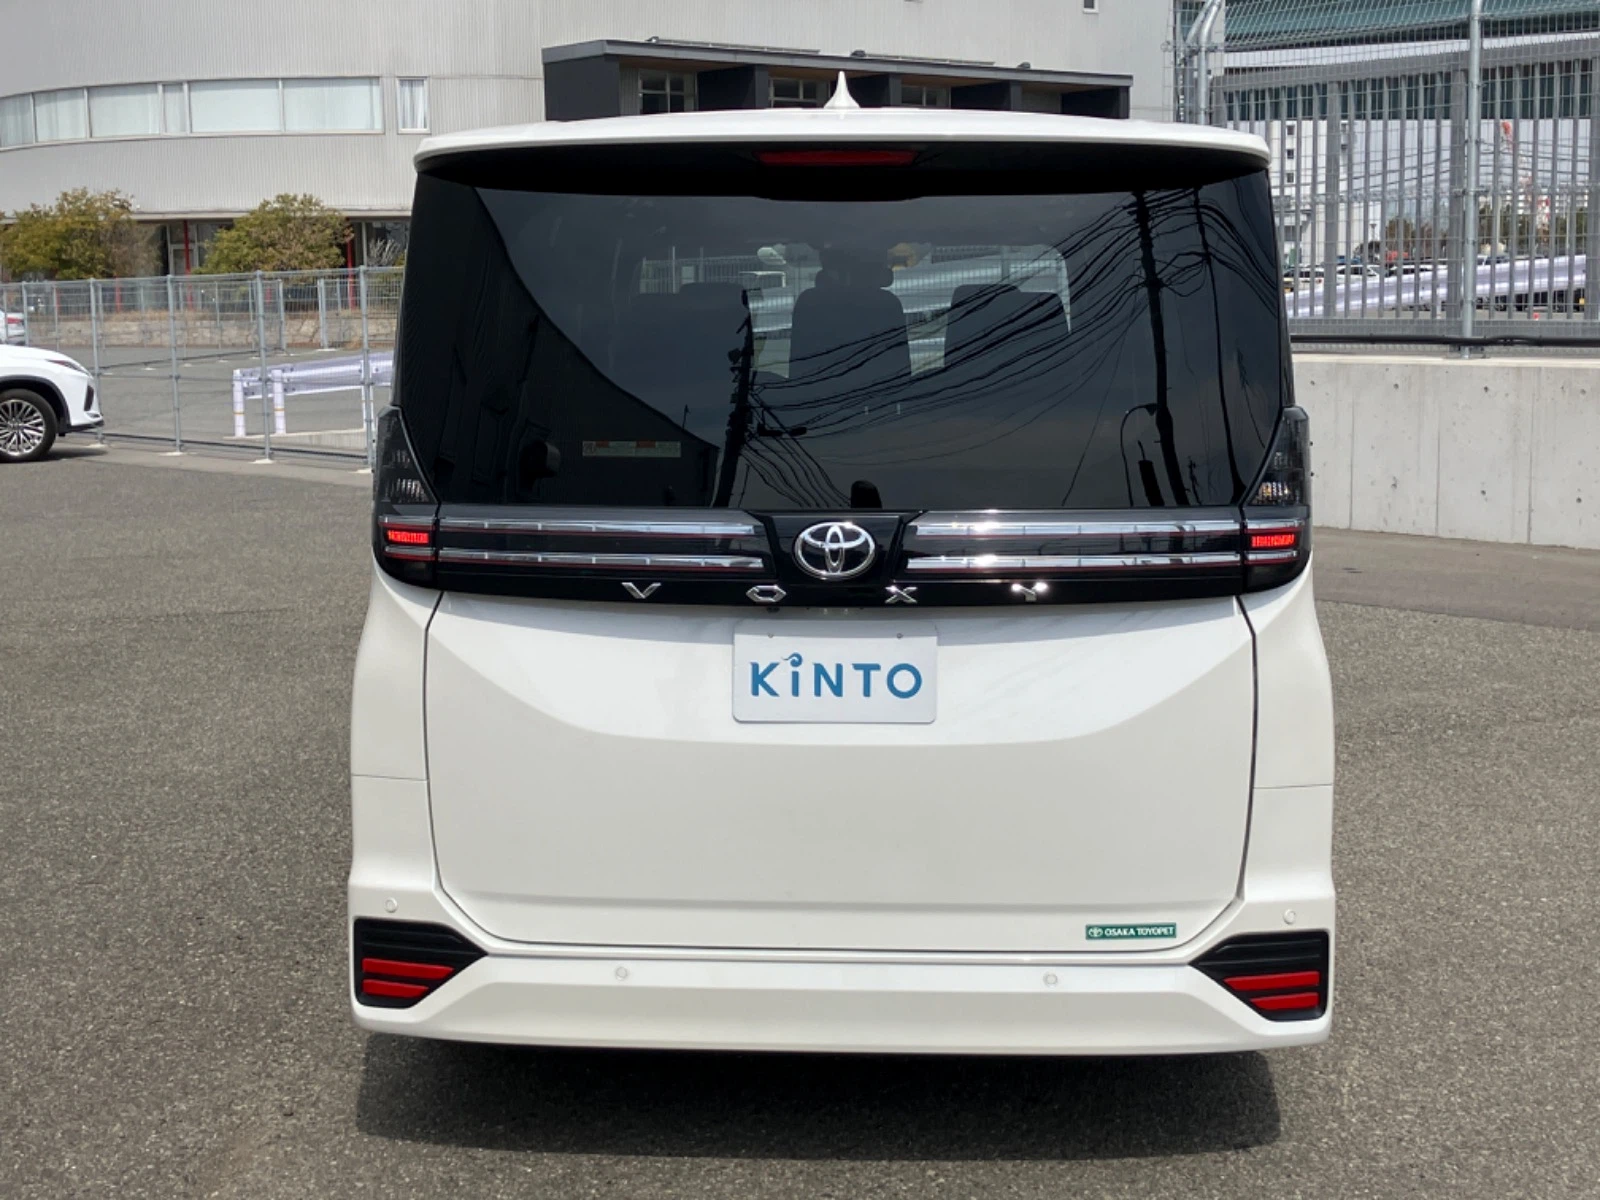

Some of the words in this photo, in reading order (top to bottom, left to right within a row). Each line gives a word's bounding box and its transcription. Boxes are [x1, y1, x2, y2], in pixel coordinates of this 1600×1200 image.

[621, 581, 1049, 603] VOXY
[1104, 927, 1136, 936] OSAKA
[1136, 926, 1174, 936] TOYOPET
